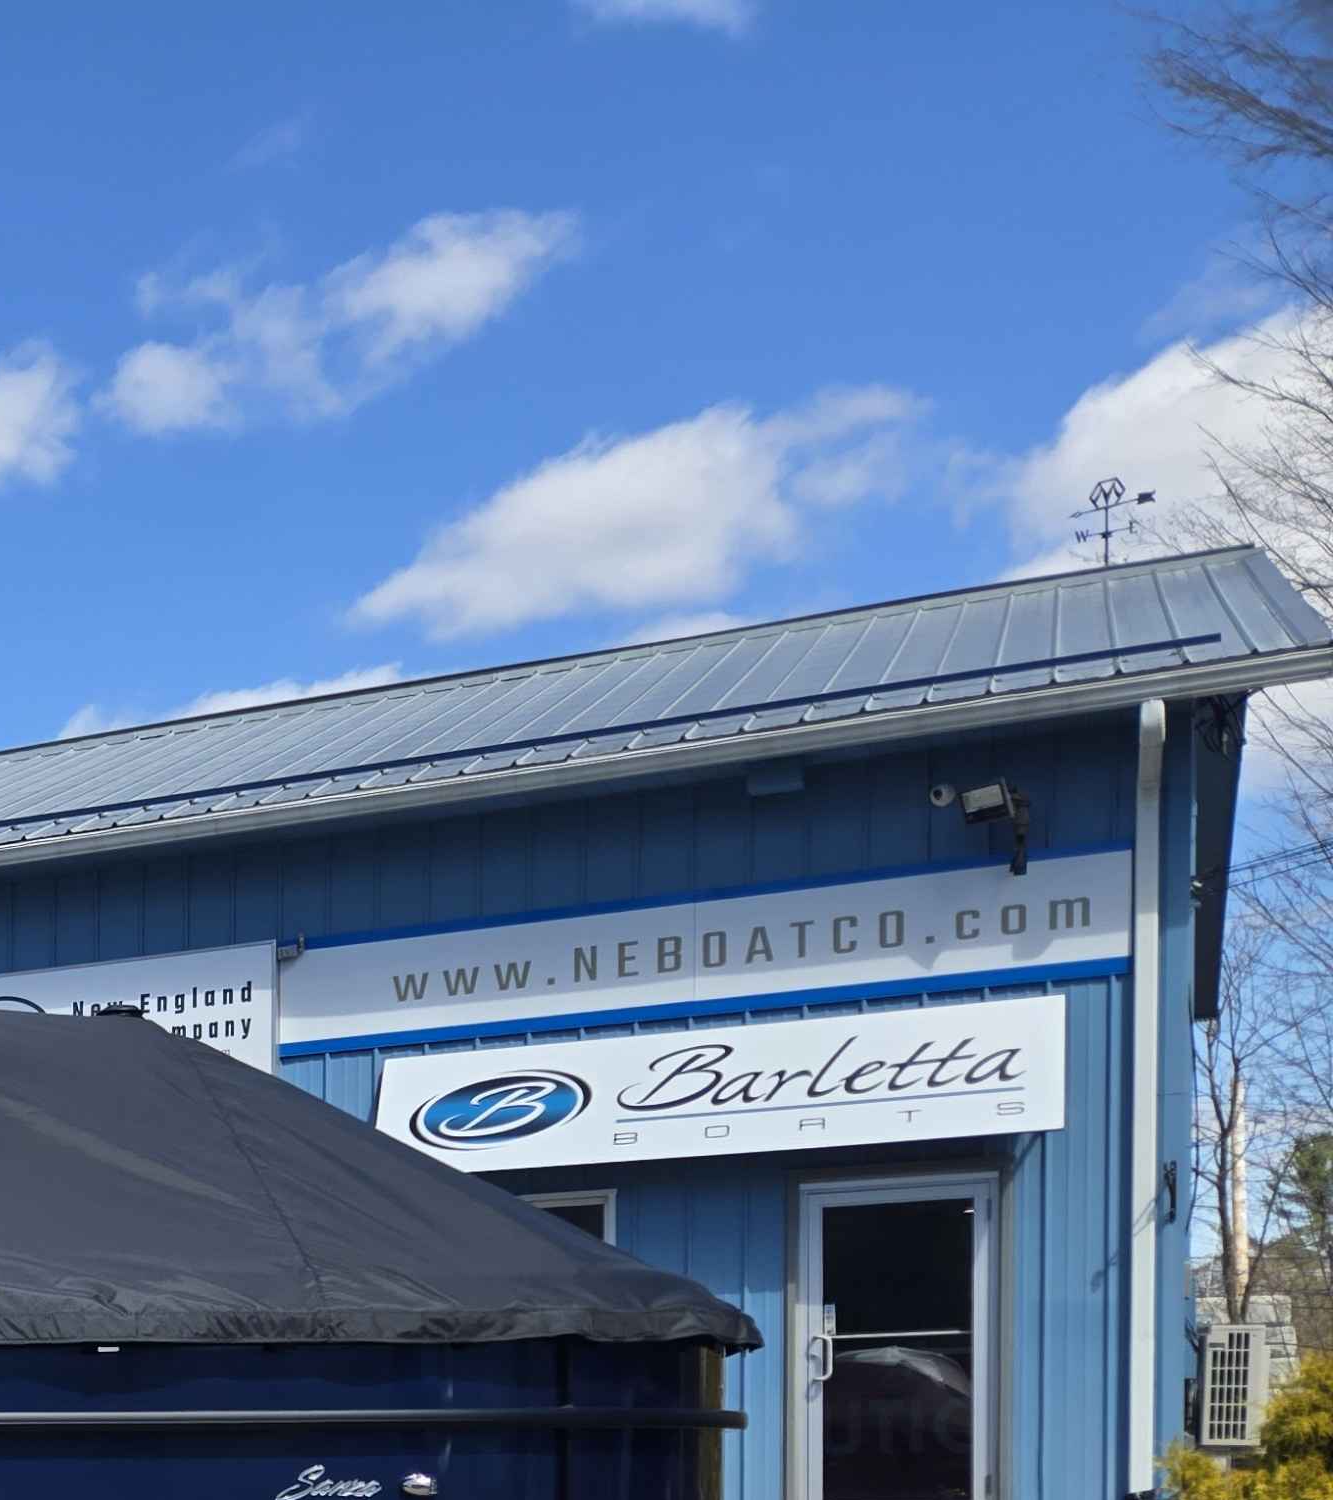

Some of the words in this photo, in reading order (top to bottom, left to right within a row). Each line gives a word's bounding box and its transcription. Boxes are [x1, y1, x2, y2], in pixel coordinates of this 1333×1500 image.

[392, 895, 1093, 1003] www.NEBOATCO.com
[139, 980, 253, 1014] England
[616, 1034, 1026, 1112] Barletta
[612, 1101, 1026, 1146] BOATS
